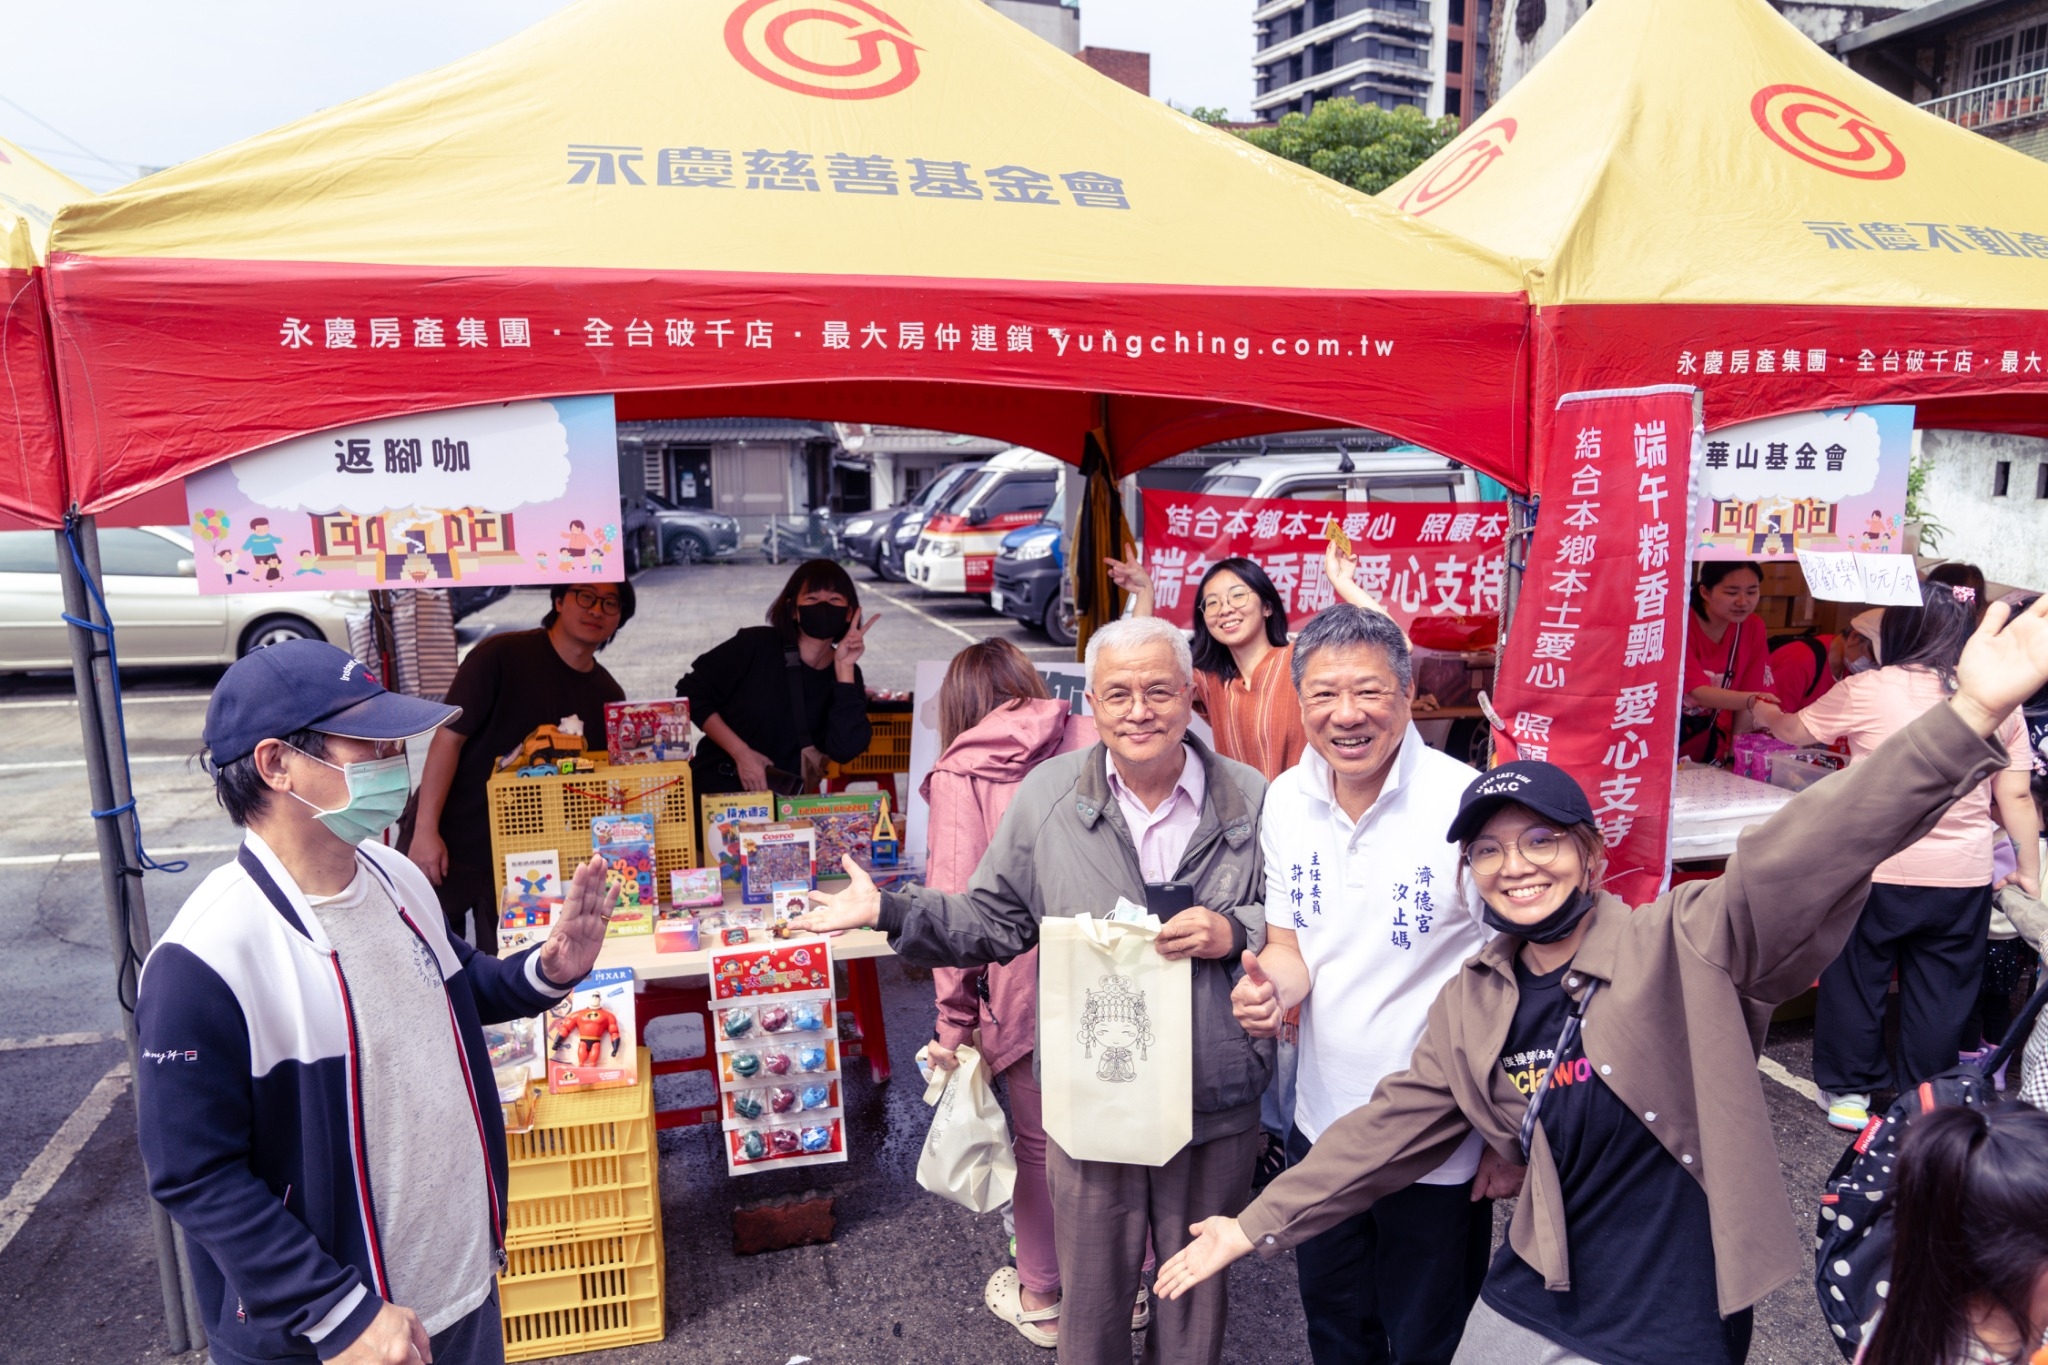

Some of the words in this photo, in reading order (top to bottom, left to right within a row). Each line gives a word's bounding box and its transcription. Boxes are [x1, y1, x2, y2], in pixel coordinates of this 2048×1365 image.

[566, 143, 1132, 210] 永慶慈善基金會
[279, 316, 531, 350] 永慶房產集團
[583, 317, 775, 349] 全台破千店
[821, 320, 1034, 353] 最大房仲連鎖
[1056, 329, 1396, 360] yungching.com.tw
[1676, 349, 1828, 375] 永慶房產集團
[1856, 348, 1974, 374] 全台破千店
[2000, 350, 2048, 375] 最大
[334, 437, 471, 474] 返腳咖
[1704, 440, 1848, 472] 華山基金會
[1165, 502, 1397, 543] 結合本鄉本土愛心
[1416, 511, 1511, 543] 照顧本
[1623, 419, 1670, 667] 端午粽香飄
[1525, 426, 1603, 690] 結合本鄉本土愛心
[1309, 851, 1323, 916] 主任委員
[1413, 865, 1436, 935] 濟德宮
[1390, 882, 1412, 951] 汐止媽
